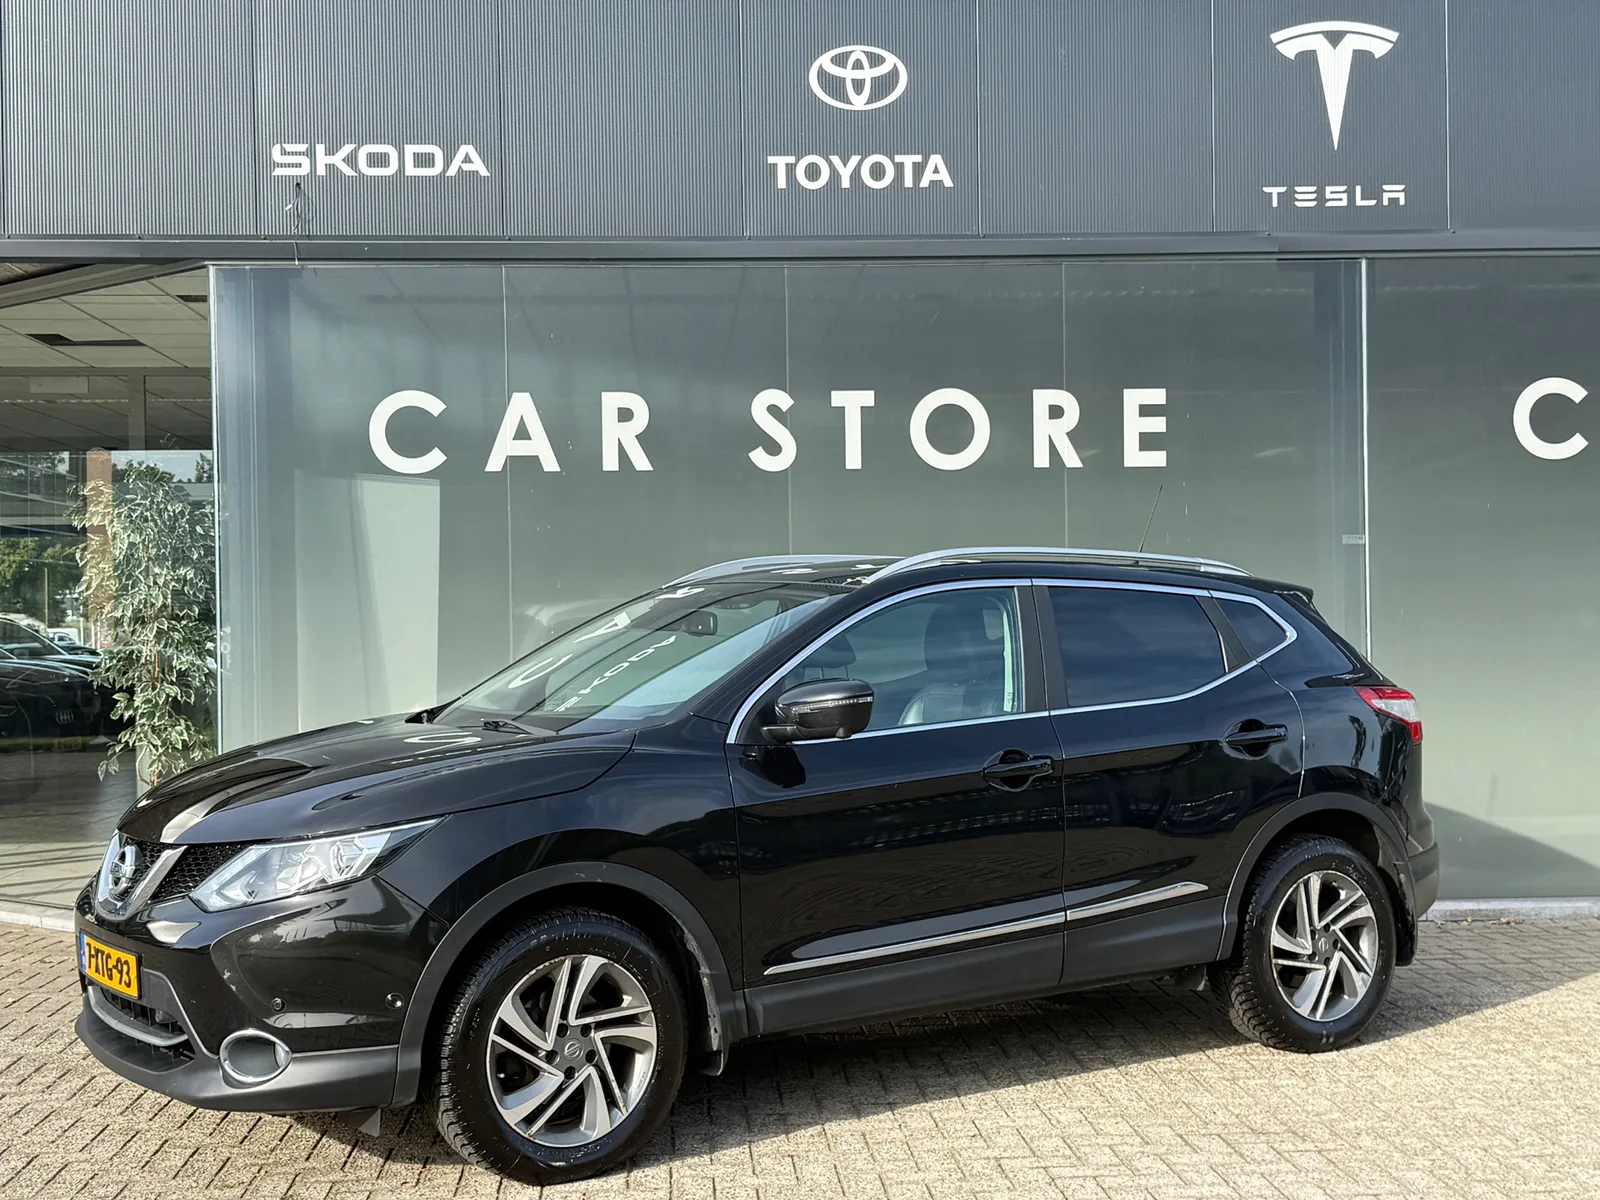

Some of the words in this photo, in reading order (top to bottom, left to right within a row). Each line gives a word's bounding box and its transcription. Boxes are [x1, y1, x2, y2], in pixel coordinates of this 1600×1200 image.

[271, 143, 491, 178] SKODA
[767, 153, 954, 190] TOYOTA
[1262, 184, 1406, 208] TESLA
[368, 389, 654, 475] CAR
[747, 387, 1168, 473] STORE
[1512, 376, 1588, 461] C
